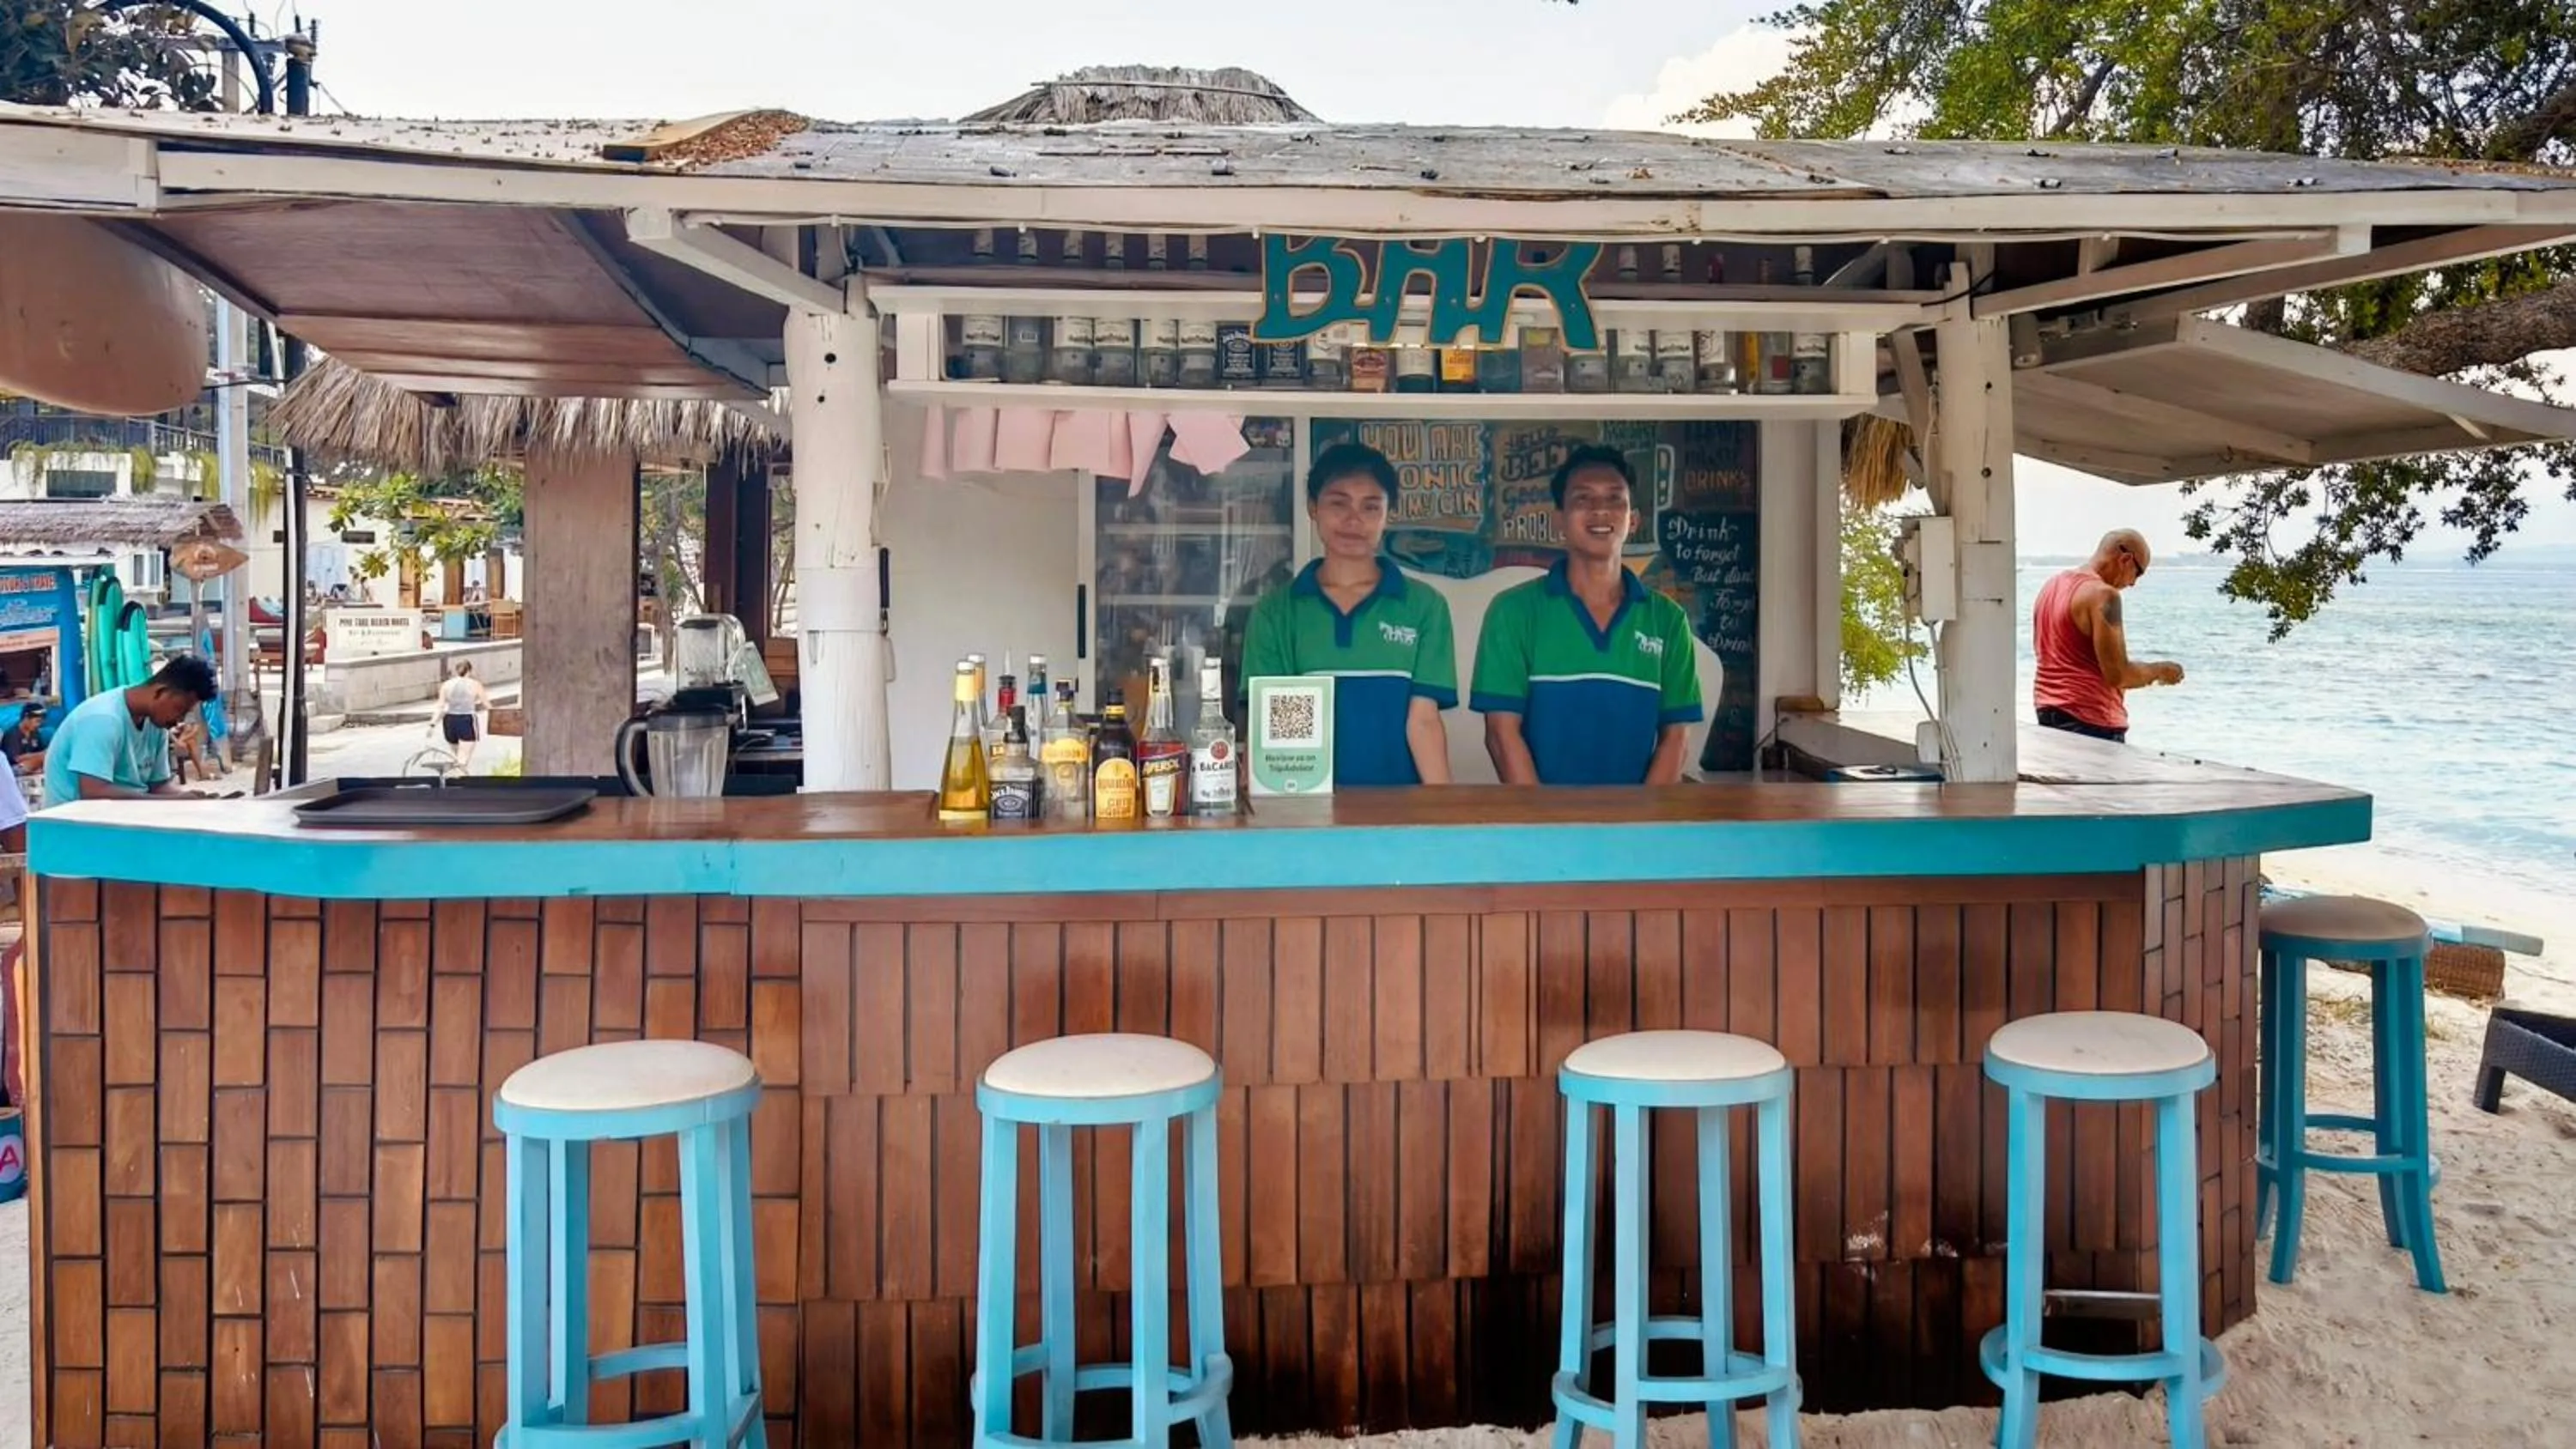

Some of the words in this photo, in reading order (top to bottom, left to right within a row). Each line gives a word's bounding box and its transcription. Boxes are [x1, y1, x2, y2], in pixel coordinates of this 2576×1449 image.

[1251, 233, 1604, 351] BAR
[1359, 423, 1422, 461] YOU
[1429, 423, 1481, 461] ARE
[1501, 441, 1568, 482] BEE
[1398, 463, 1480, 492] ONIC
[1503, 510, 1567, 541] PROBL
[1667, 516, 1739, 540] Drink
[1675, 542, 1692, 560] to
[1694, 543, 1740, 564] forget
